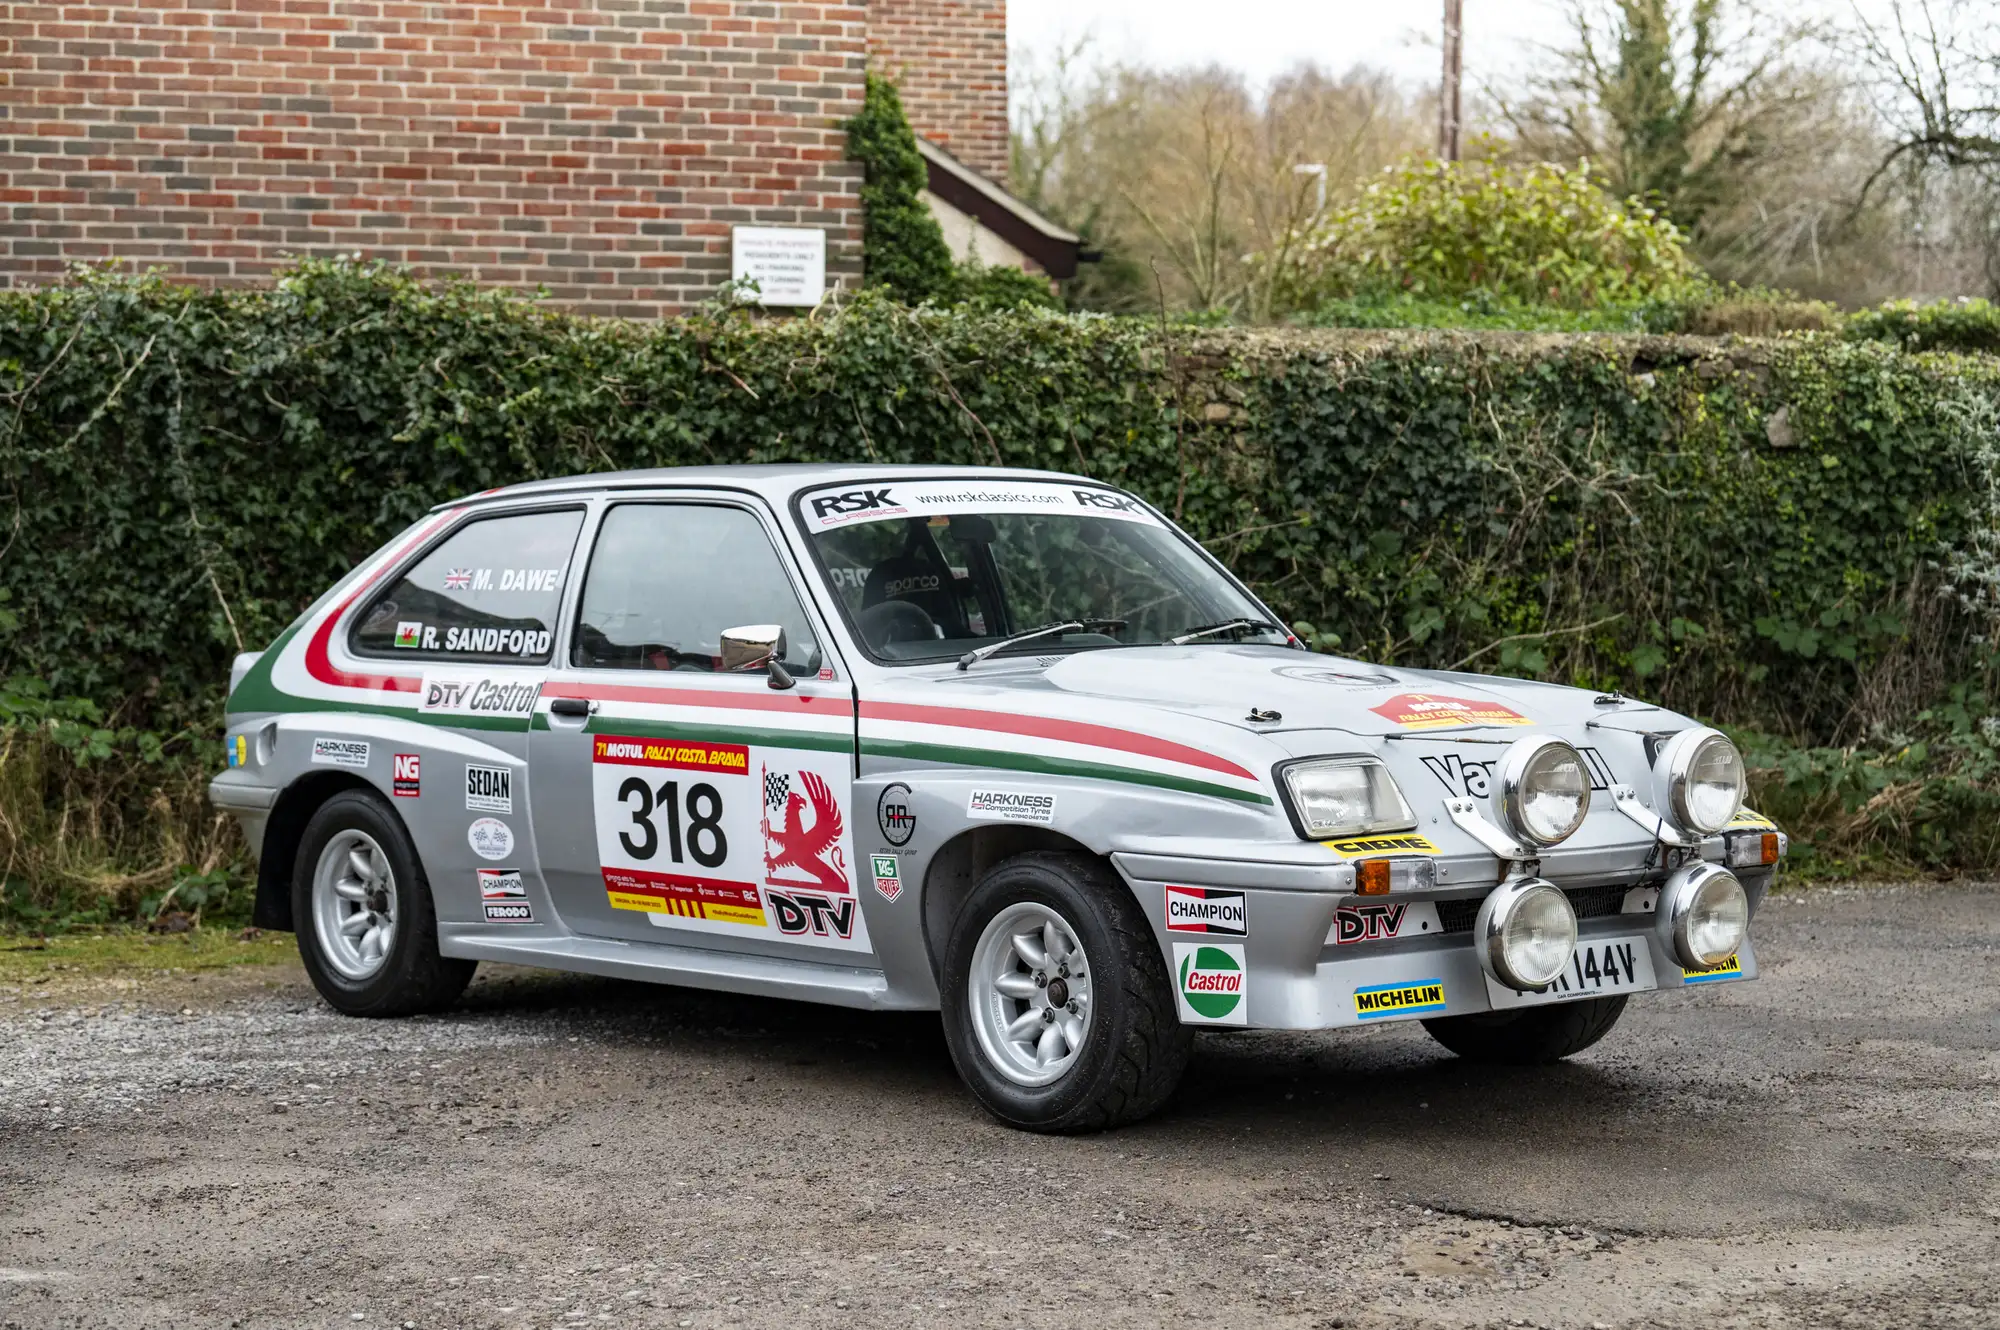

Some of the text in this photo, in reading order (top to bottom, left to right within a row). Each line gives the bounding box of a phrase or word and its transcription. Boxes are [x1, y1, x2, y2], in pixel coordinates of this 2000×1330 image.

[811, 489, 901, 518] RSK
[915, 491, 1064, 504] www.rskclassics.com
[1072, 490, 1145, 515] RSK
[822, 507, 908, 525] CLASSICS
[472, 568, 558, 592] M. DAWE
[884, 575, 939, 592] sparco
[422, 626, 551, 654] R. SANDFORD
[425, 680, 473, 709] DTV
[470, 679, 543, 713] Castrol
[1405, 694, 1434, 702] 71
[1398, 711, 1435, 722] RALLY
[1408, 702, 1471, 712] MOTUL
[316, 741, 367, 754] HARKNESS
[596, 742, 746, 768] 71 MOTUL RALLY COSTA BRAVA
[395, 756, 419, 779] NG
[468, 769, 509, 798] SEDAN
[972, 792, 1053, 808] HARKNESS
[985, 804, 1051, 815] Competition Tyres
[617, 776, 729, 868] 318
[1334, 837, 1432, 852] CIBIE
[876, 860, 894, 876] TAG
[483, 879, 522, 889] CHAMPION
[878, 880, 899, 897] HEUER
[486, 906, 528, 917] FERODO
[764, 887, 857, 939] DTV
[1170, 901, 1242, 922] CHAMPION
[1333, 901, 1410, 945] DTV
[1188, 971, 1242, 993] Castrol
[1359, 987, 1441, 1010] MICHELIN
[1567, 990, 1596, 998] COMPONENTS
